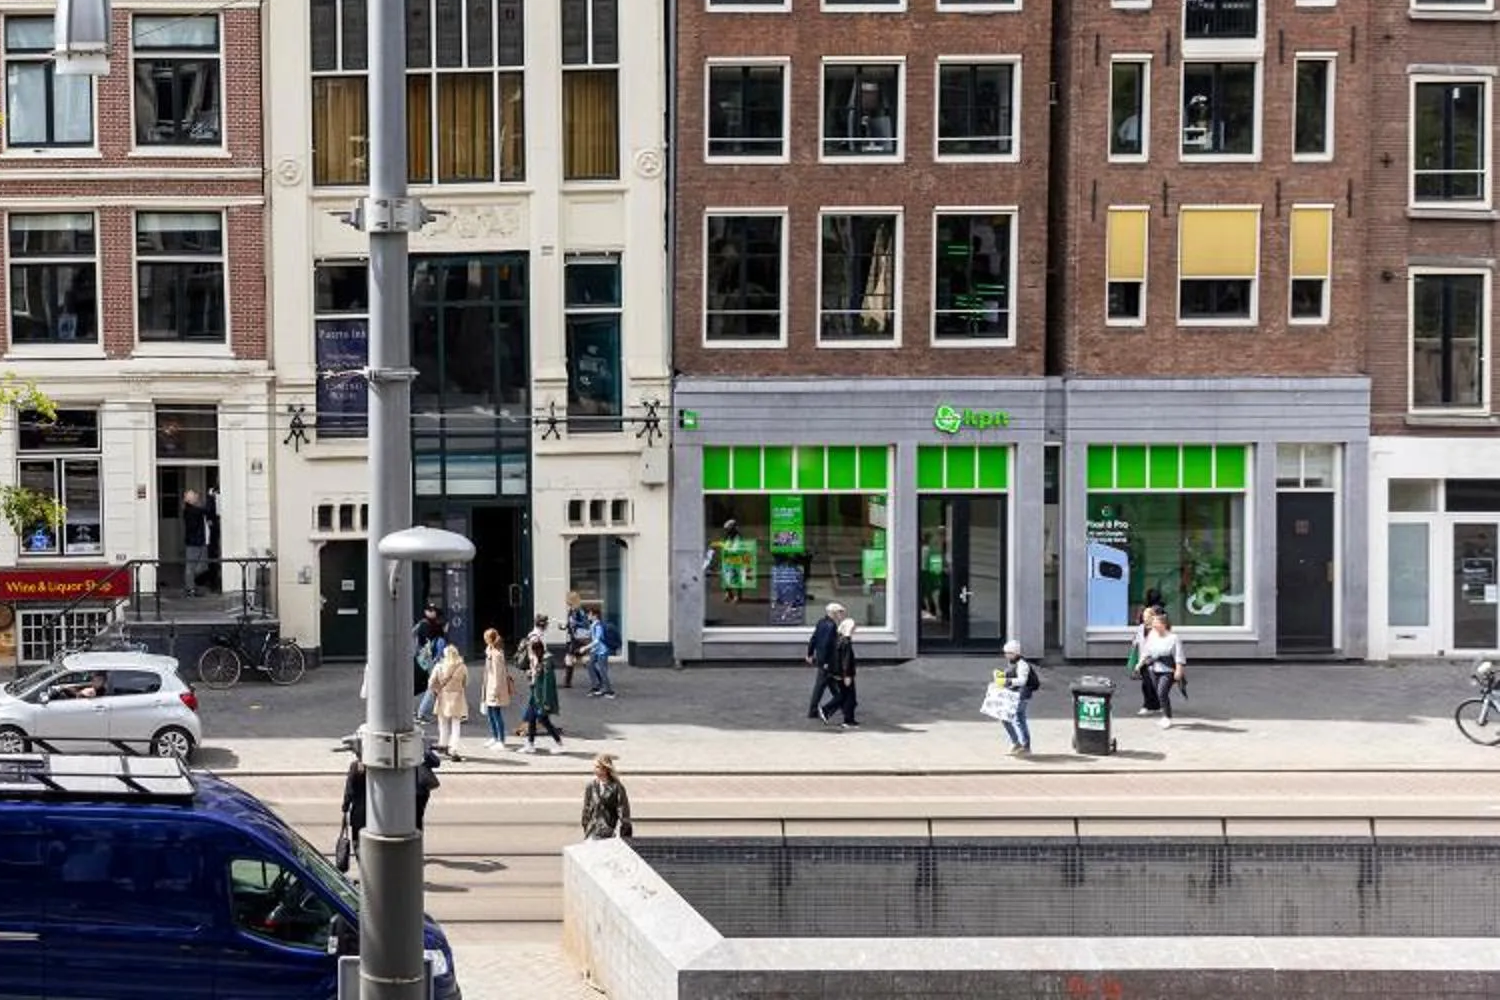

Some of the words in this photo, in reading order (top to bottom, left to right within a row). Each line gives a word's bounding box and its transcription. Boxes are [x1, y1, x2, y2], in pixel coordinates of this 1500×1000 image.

[963, 408, 1010, 429] kpn
[5, 581, 36, 592] Wine
[38, 581, 46, 592] &
[48, 581, 82, 594] Liquor
